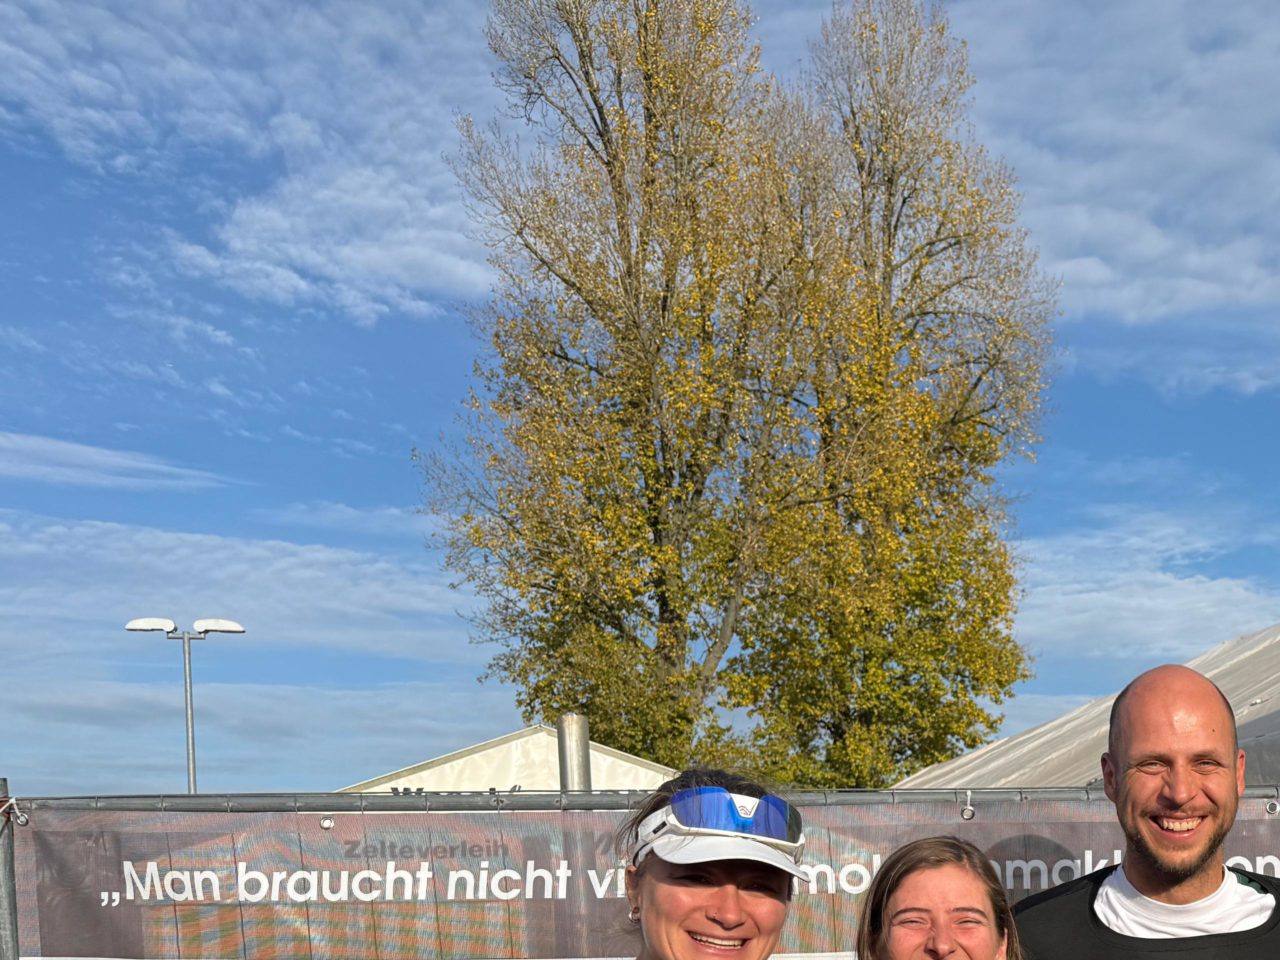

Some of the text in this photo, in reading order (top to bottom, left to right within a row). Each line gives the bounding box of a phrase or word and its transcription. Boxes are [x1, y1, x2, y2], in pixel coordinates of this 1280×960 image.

[343, 838, 510, 861] Zelteverleih
[237, 860, 433, 902] braucht
[448, 859, 572, 900] nicht
